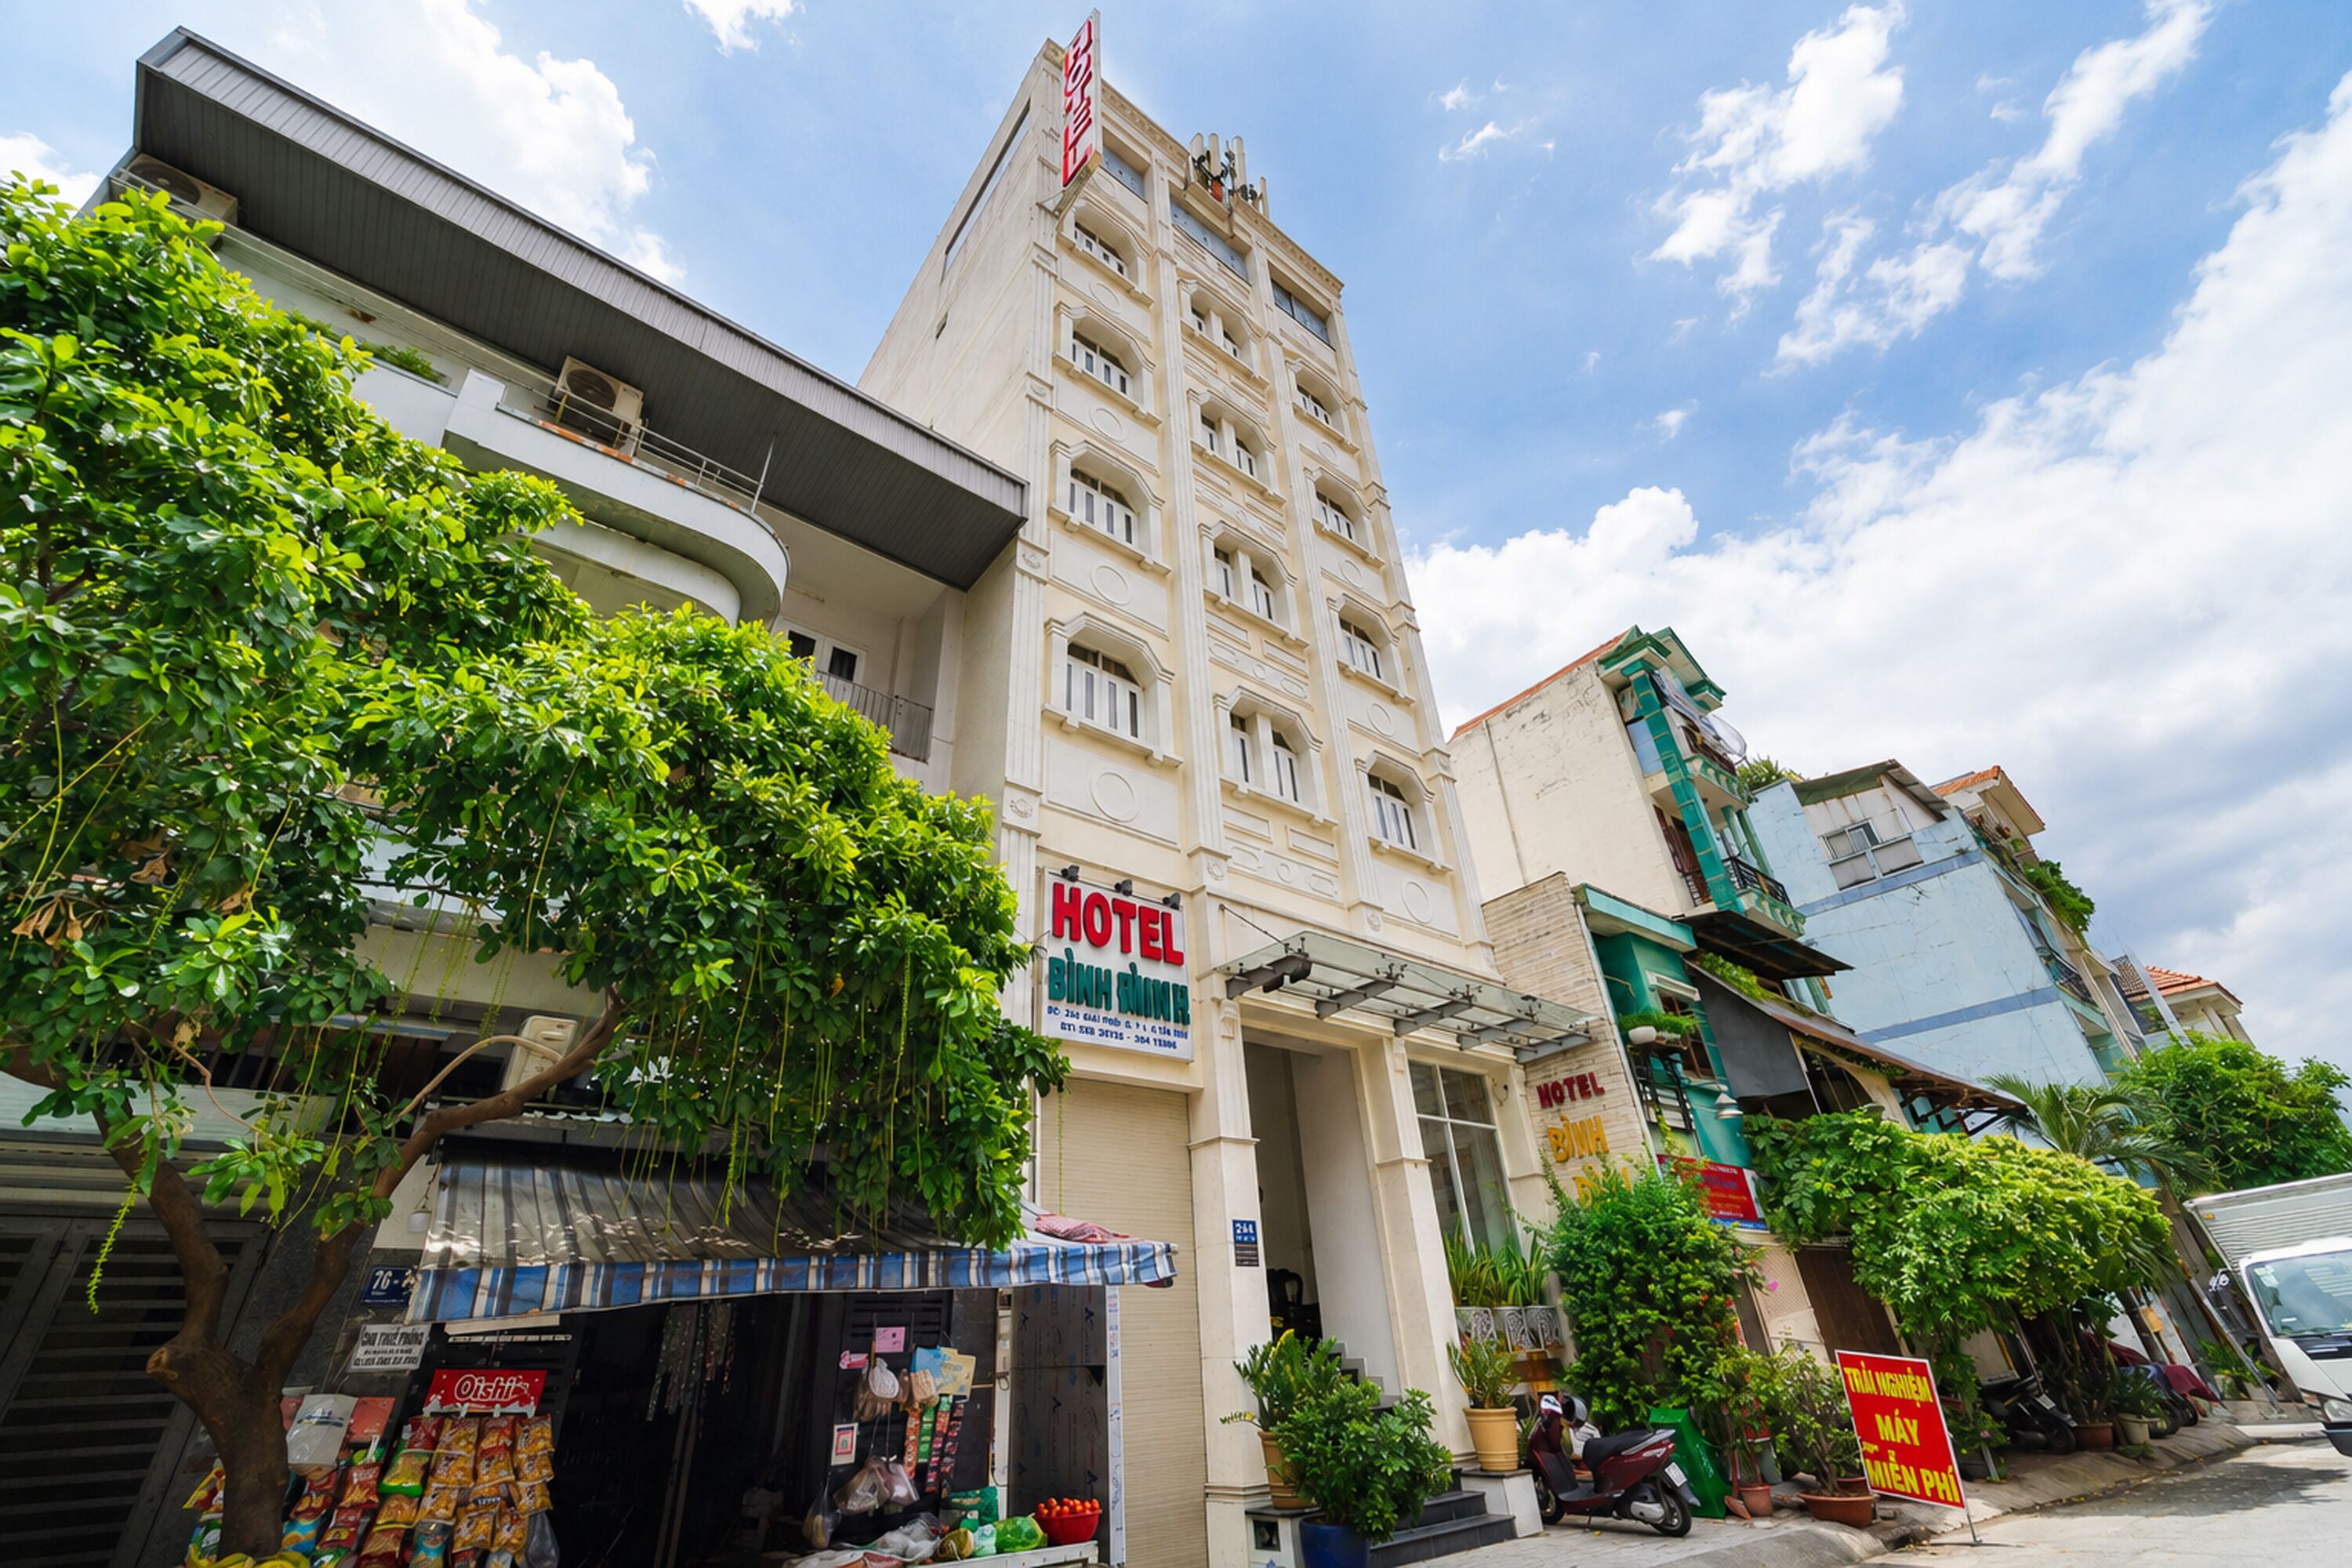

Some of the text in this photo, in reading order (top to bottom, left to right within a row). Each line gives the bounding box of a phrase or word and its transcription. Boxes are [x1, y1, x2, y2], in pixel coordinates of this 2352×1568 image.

[1063, 20, 1092, 187] HOTEL
[1052, 882, 1184, 966] HOTEL
[1048, 947, 1112, 1011] BÌNH
[1536, 1071, 1606, 1109] HOTEL
[1547, 1112, 1610, 1163] BÌNH
[1875, 1408, 1920, 1446] MÁY
[1920, 1465, 1961, 1503] PHÍ
